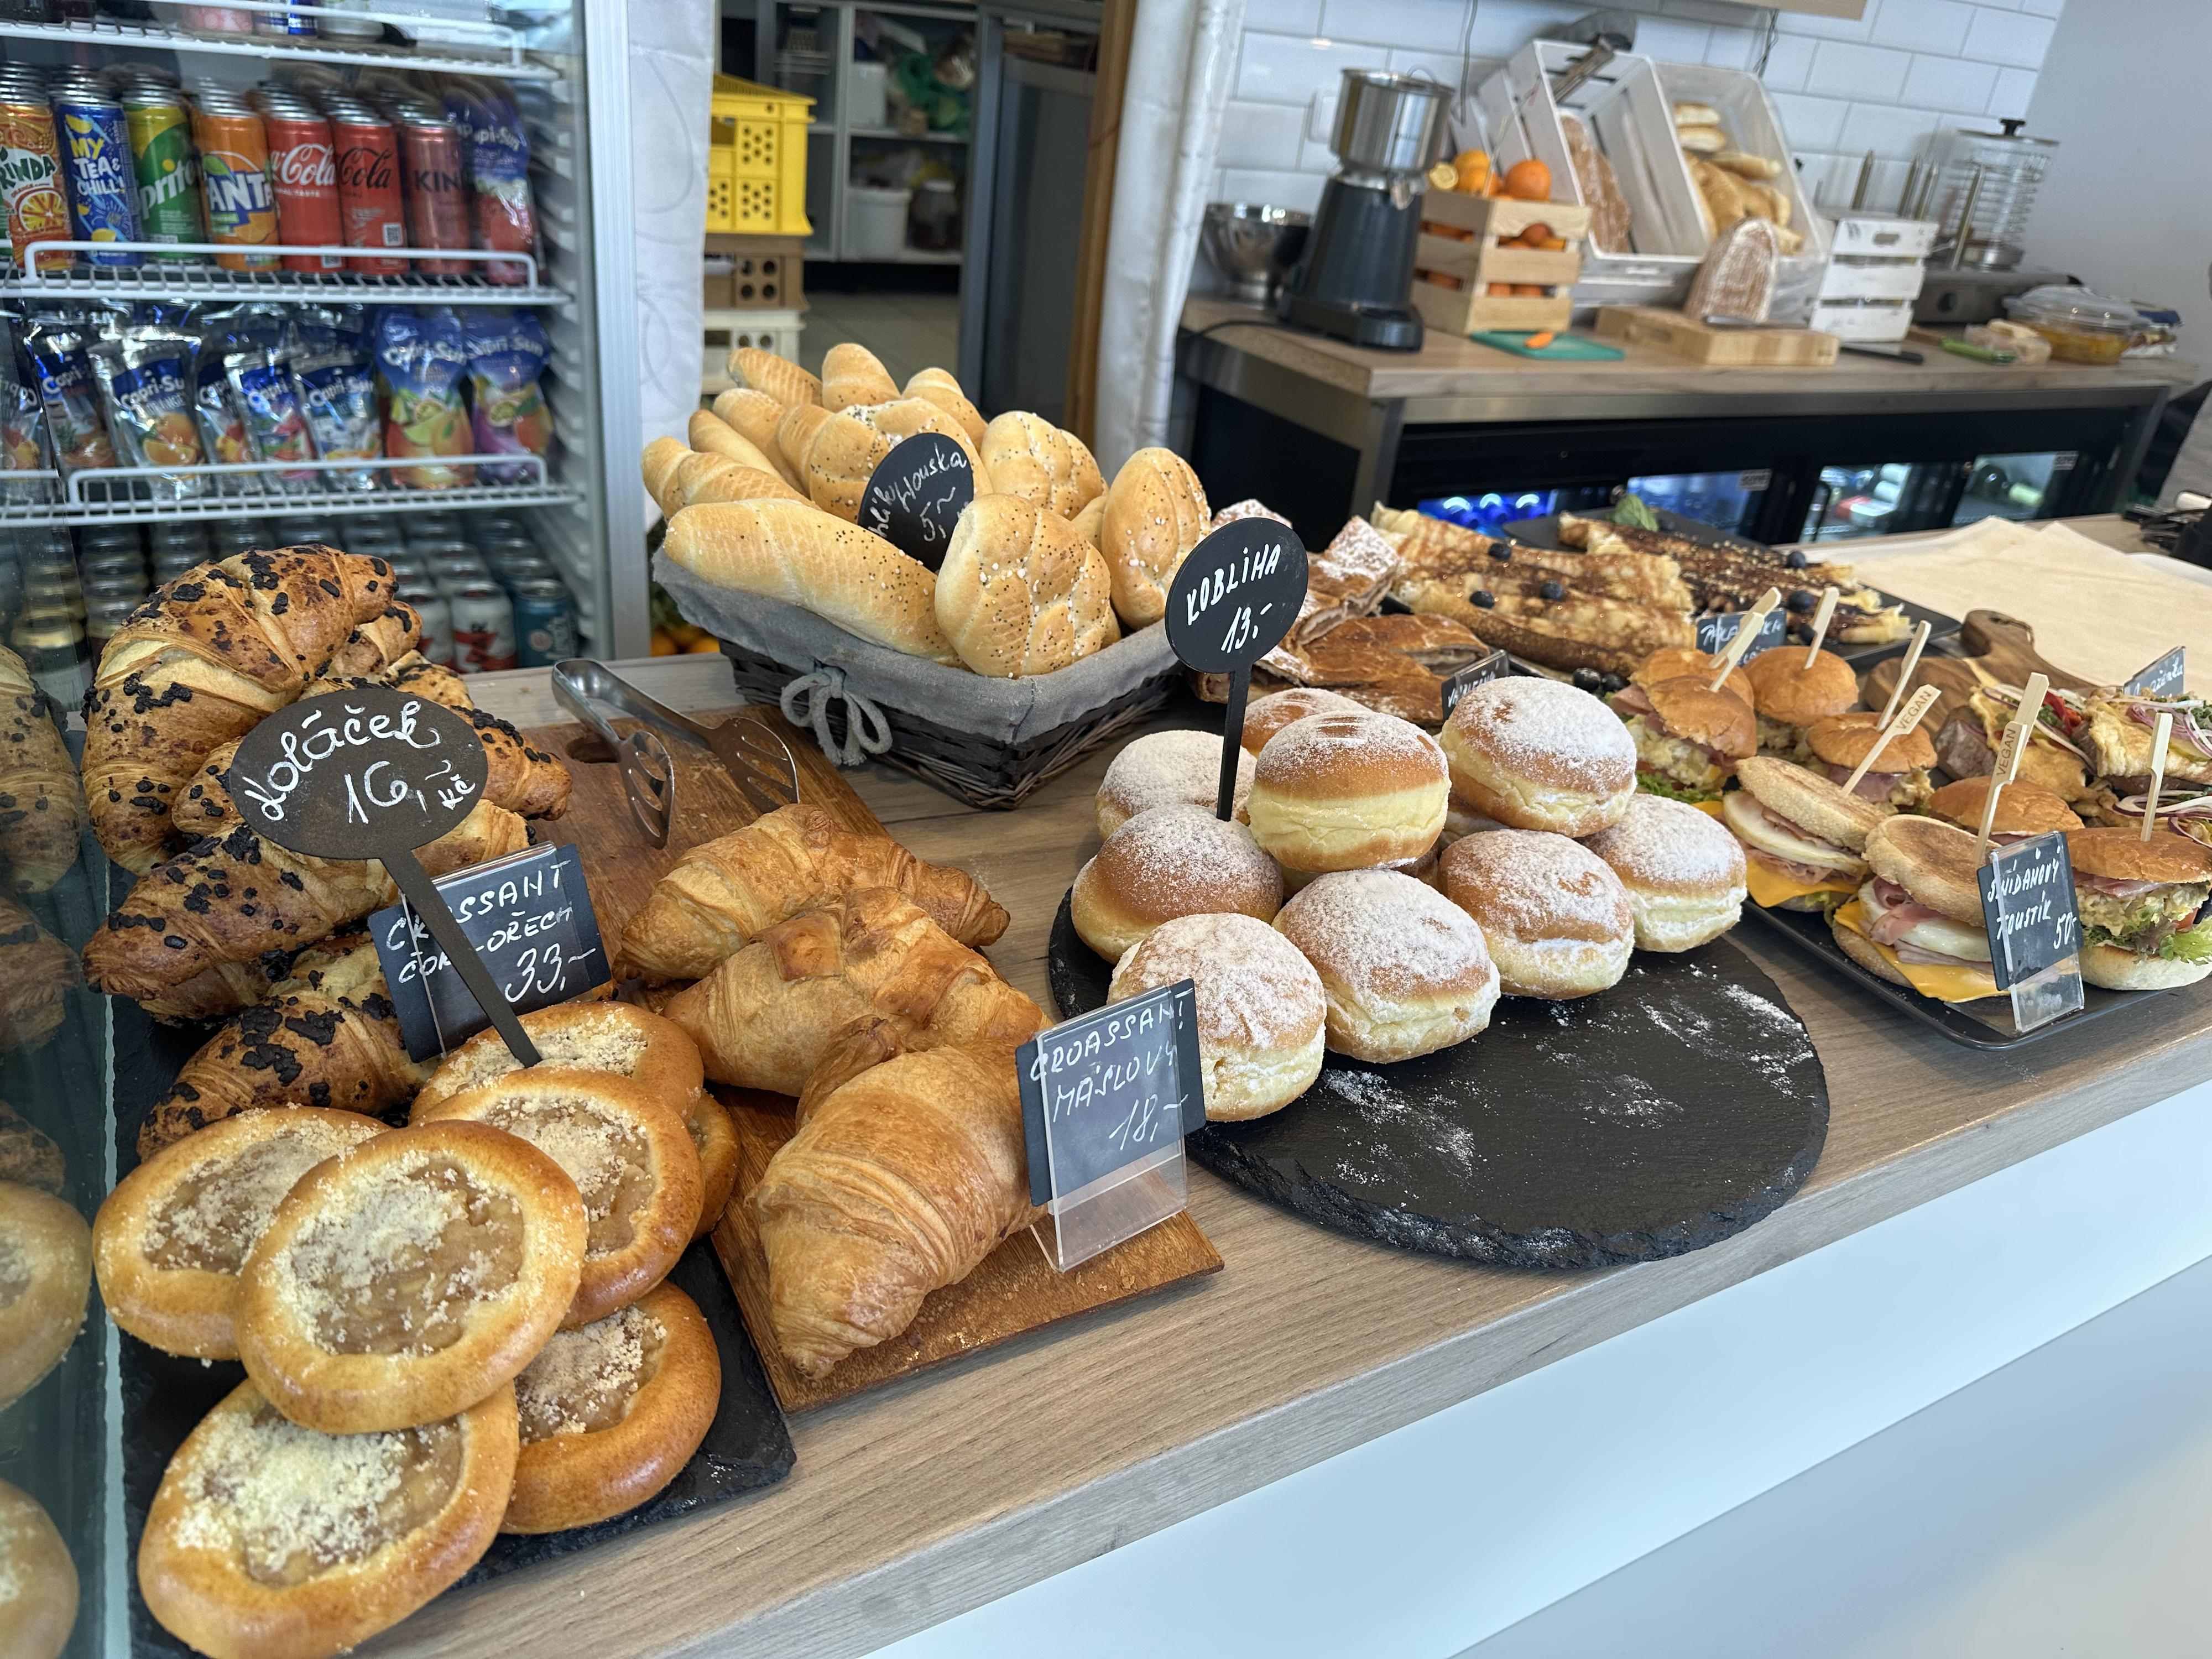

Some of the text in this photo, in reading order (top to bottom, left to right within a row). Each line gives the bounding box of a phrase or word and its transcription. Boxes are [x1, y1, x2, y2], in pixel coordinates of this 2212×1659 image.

[71, 137, 104, 160] MY
[204, 171, 274, 211] ANTA
[1895, 691, 1932, 730] VEGAN
[1996, 728, 2016, 775] VEGAN
